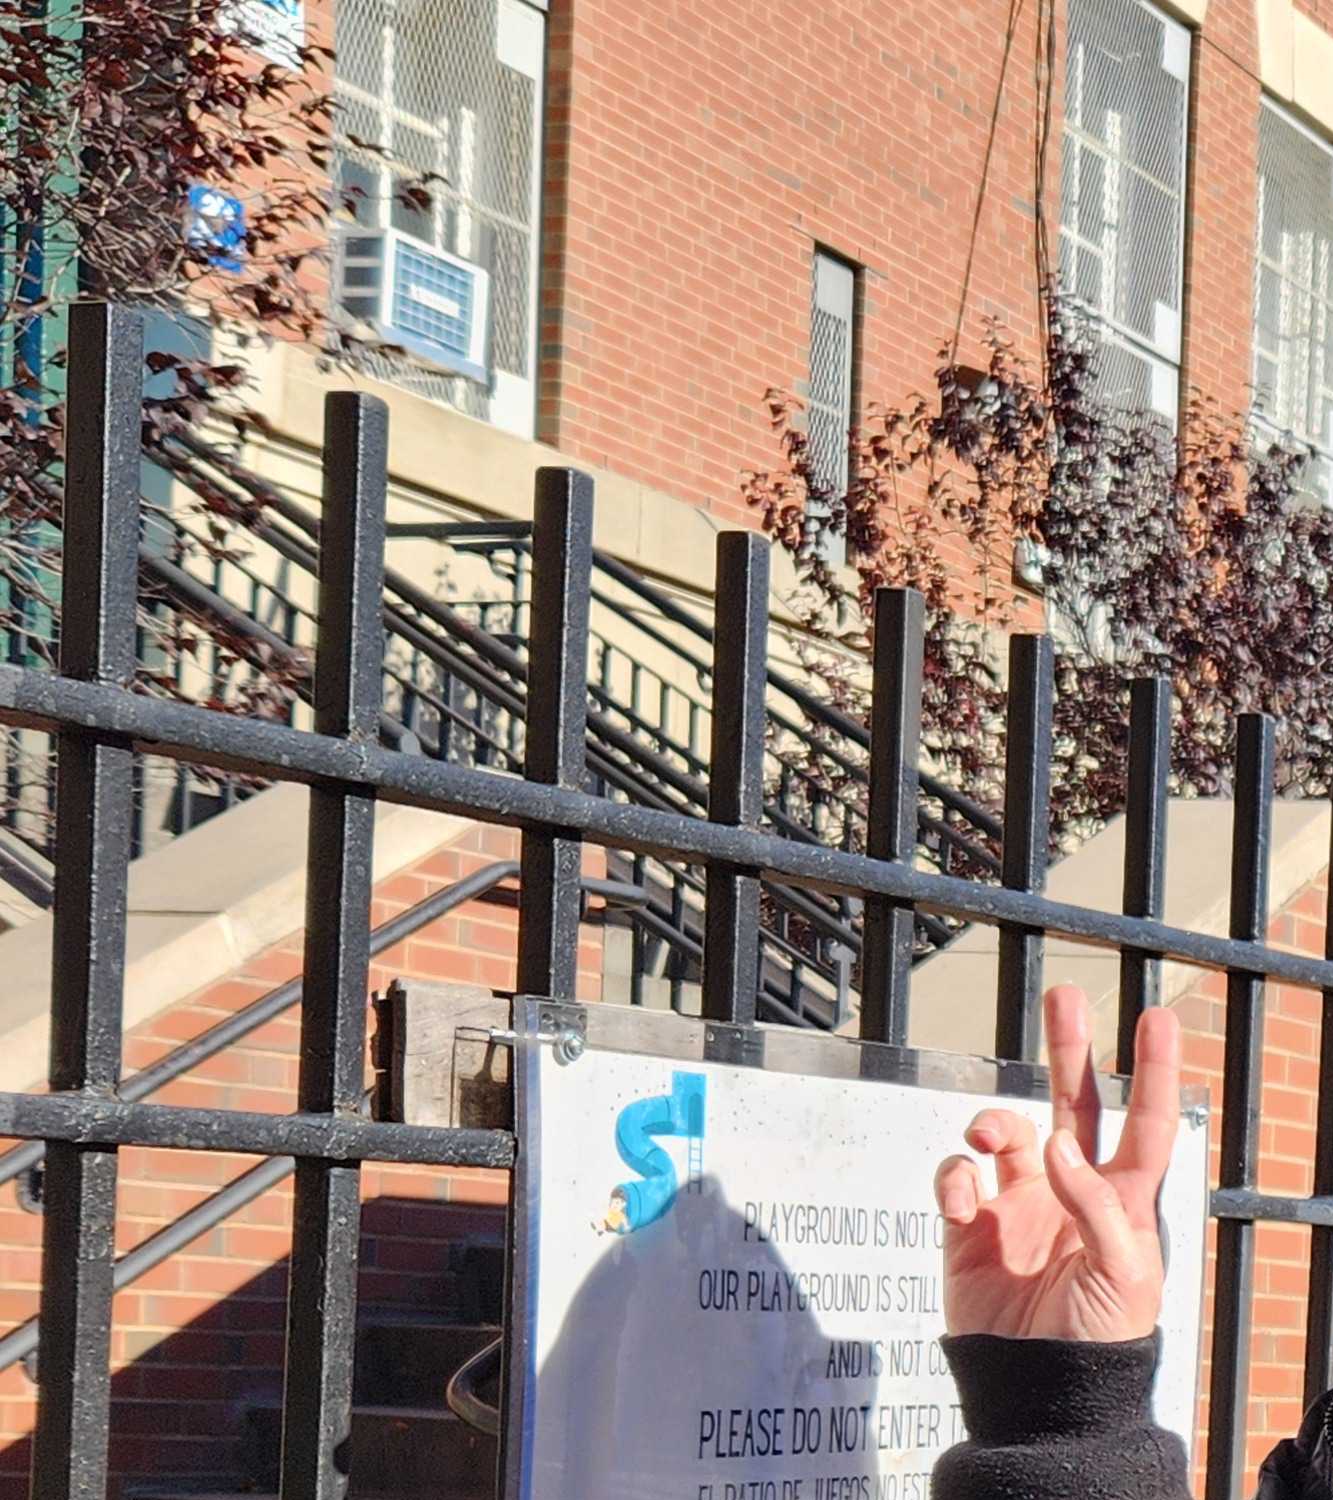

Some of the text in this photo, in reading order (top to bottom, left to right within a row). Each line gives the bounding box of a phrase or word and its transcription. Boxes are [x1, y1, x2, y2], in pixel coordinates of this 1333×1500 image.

[744, 1202, 867, 1247] PLAYGROUND
[873, 1209, 890, 1248] IS
[895, 1211, 928, 1249] NOT
[699, 1270, 939, 1314] OUR PLAYGROUND IS STILL
[825, 1340, 863, 1379] AND
[867, 1341, 883, 1378] IS
[889, 1340, 923, 1378] NOT
[699, 1407, 785, 1460] PLEASE
[791, 1407, 822, 1455] DO
[829, 1405, 872, 1454] NOT
[878, 1404, 941, 1450] ENTER
